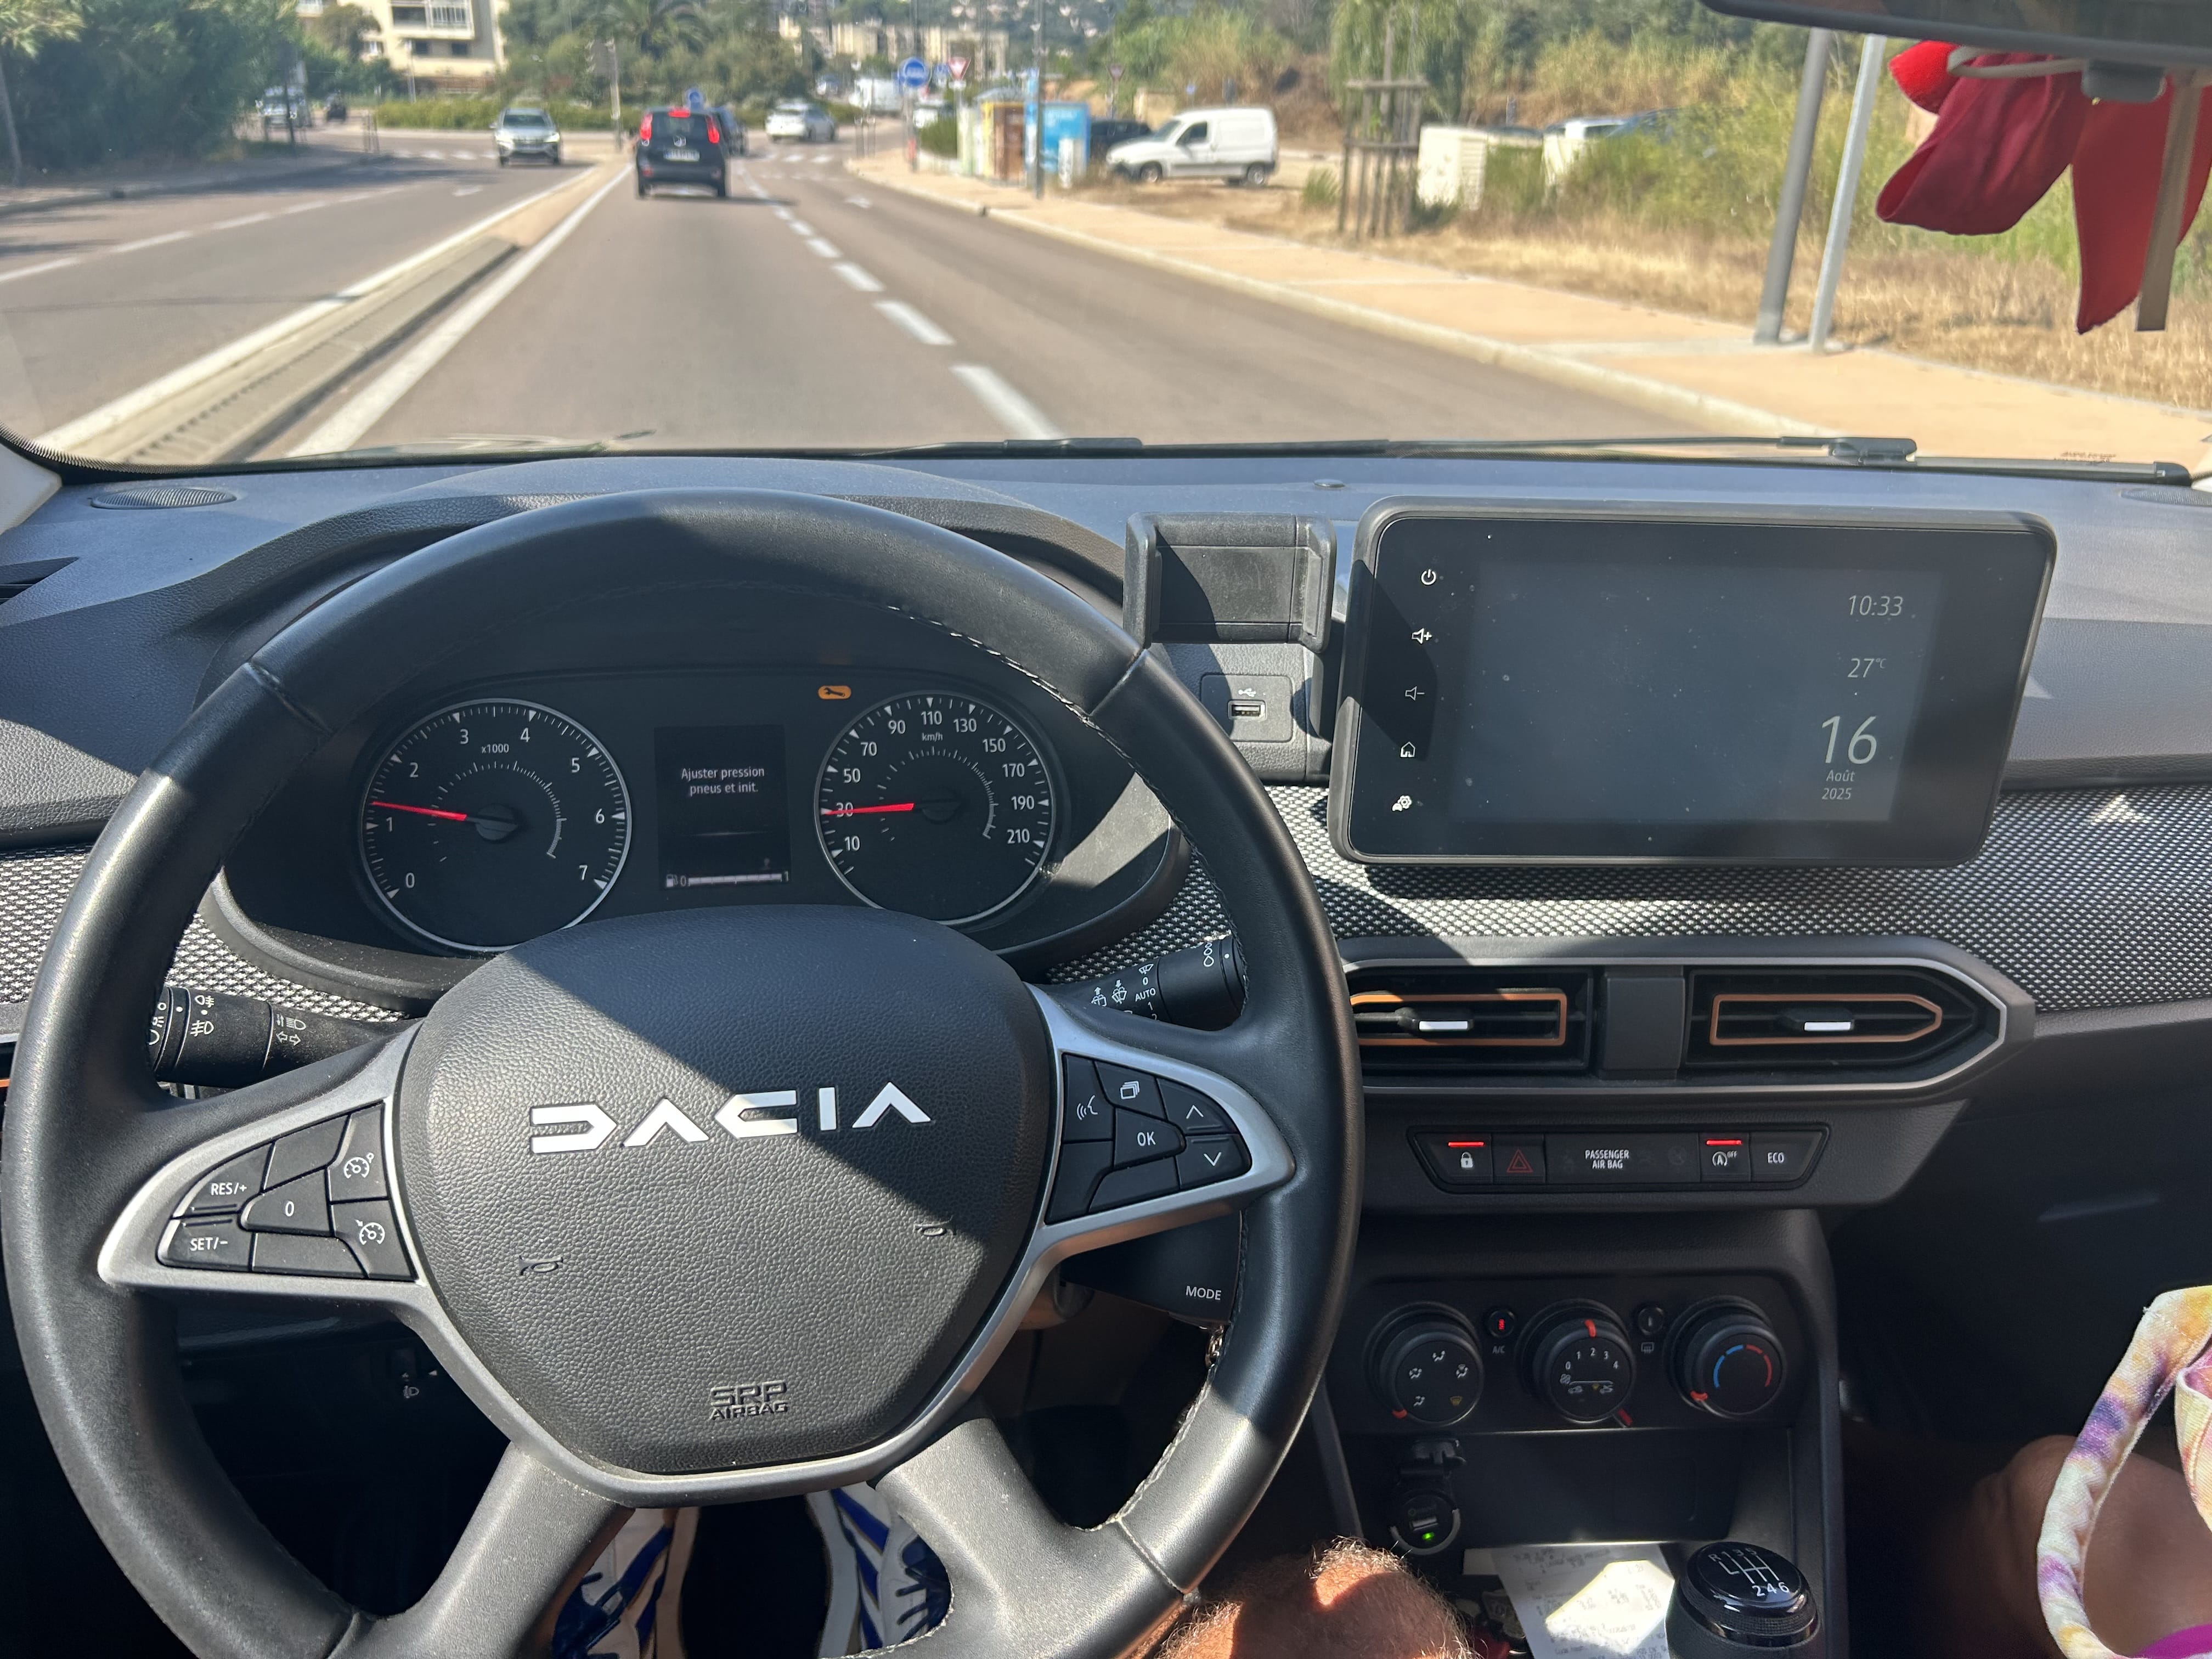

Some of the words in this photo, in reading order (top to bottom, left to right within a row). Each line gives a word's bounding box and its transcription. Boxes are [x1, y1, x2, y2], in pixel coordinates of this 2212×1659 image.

[1848, 595, 1904, 616] 10:33
[921, 710, 943, 725] 110
[888, 719, 906, 734] 90
[953, 718, 978, 733] 130
[460, 730, 469, 744] 3
[520, 728, 530, 742] 4
[922, 732, 944, 742] km/h
[1821, 715, 1877, 765] 16
[481, 743, 509, 754] x1000
[861, 742, 878, 757] 70
[983, 738, 1007, 753] 150
[410, 763, 419, 777] 2
[572, 758, 580, 772] 5
[1003, 763, 1026, 778] 170
[681, 768, 719, 780] Ajuster
[720, 766, 765, 781] pression
[843, 768, 861, 783] 50
[1826, 770, 1855, 782] Août
[690, 783, 723, 797] pneus
[725, 783, 736, 793] et
[738, 782, 759, 793] init.
[1821, 788, 1852, 800] 2025
[836, 802, 854, 817] 30
[1011, 795, 1035, 810] 190
[596, 809, 605, 824] 6
[386, 817, 393, 832] 1
[1007, 829, 1031, 844] 210
[844, 837, 861, 852] 10
[579, 865, 588, 880] 7
[405, 873, 415, 888] 0
[1135, 988, 1156, 1002] AUTO
[1148, 1001, 1153, 1011] 1
[530, 1082, 931, 1154] DACIA
[1137, 1132, 1155, 1146] OK
[1585, 1149, 1629, 1160] PASSENGER
[1768, 1152, 1784, 1164] ECO
[1592, 1159, 1606, 1169] AIR
[1607, 1159, 1623, 1169] BAG
[211, 1182, 247, 1195] RES/+
[285, 1201, 294, 1217] 0
[190, 1238, 228, 1250] SET/-
[1186, 1285, 1221, 1301] MODE
[1492, 1346, 1505, 1354] A/C
[1577, 1351, 1581, 1360] 1
[1590, 1347, 1596, 1356] 2
[1604, 1351, 1609, 1359] 3
[1565, 1361, 1571, 1370] 0
[1613, 1361, 1618, 1369] 4
[710, 1380, 787, 1407] SRP
[710, 1401, 788, 1420] AIRBAG
[1708, 1554, 1722, 1562] R
[1752, 1585, 1765, 1596] 2
[1767, 1583, 1776, 1594] 4
[1778, 1582, 1790, 1593] 6
